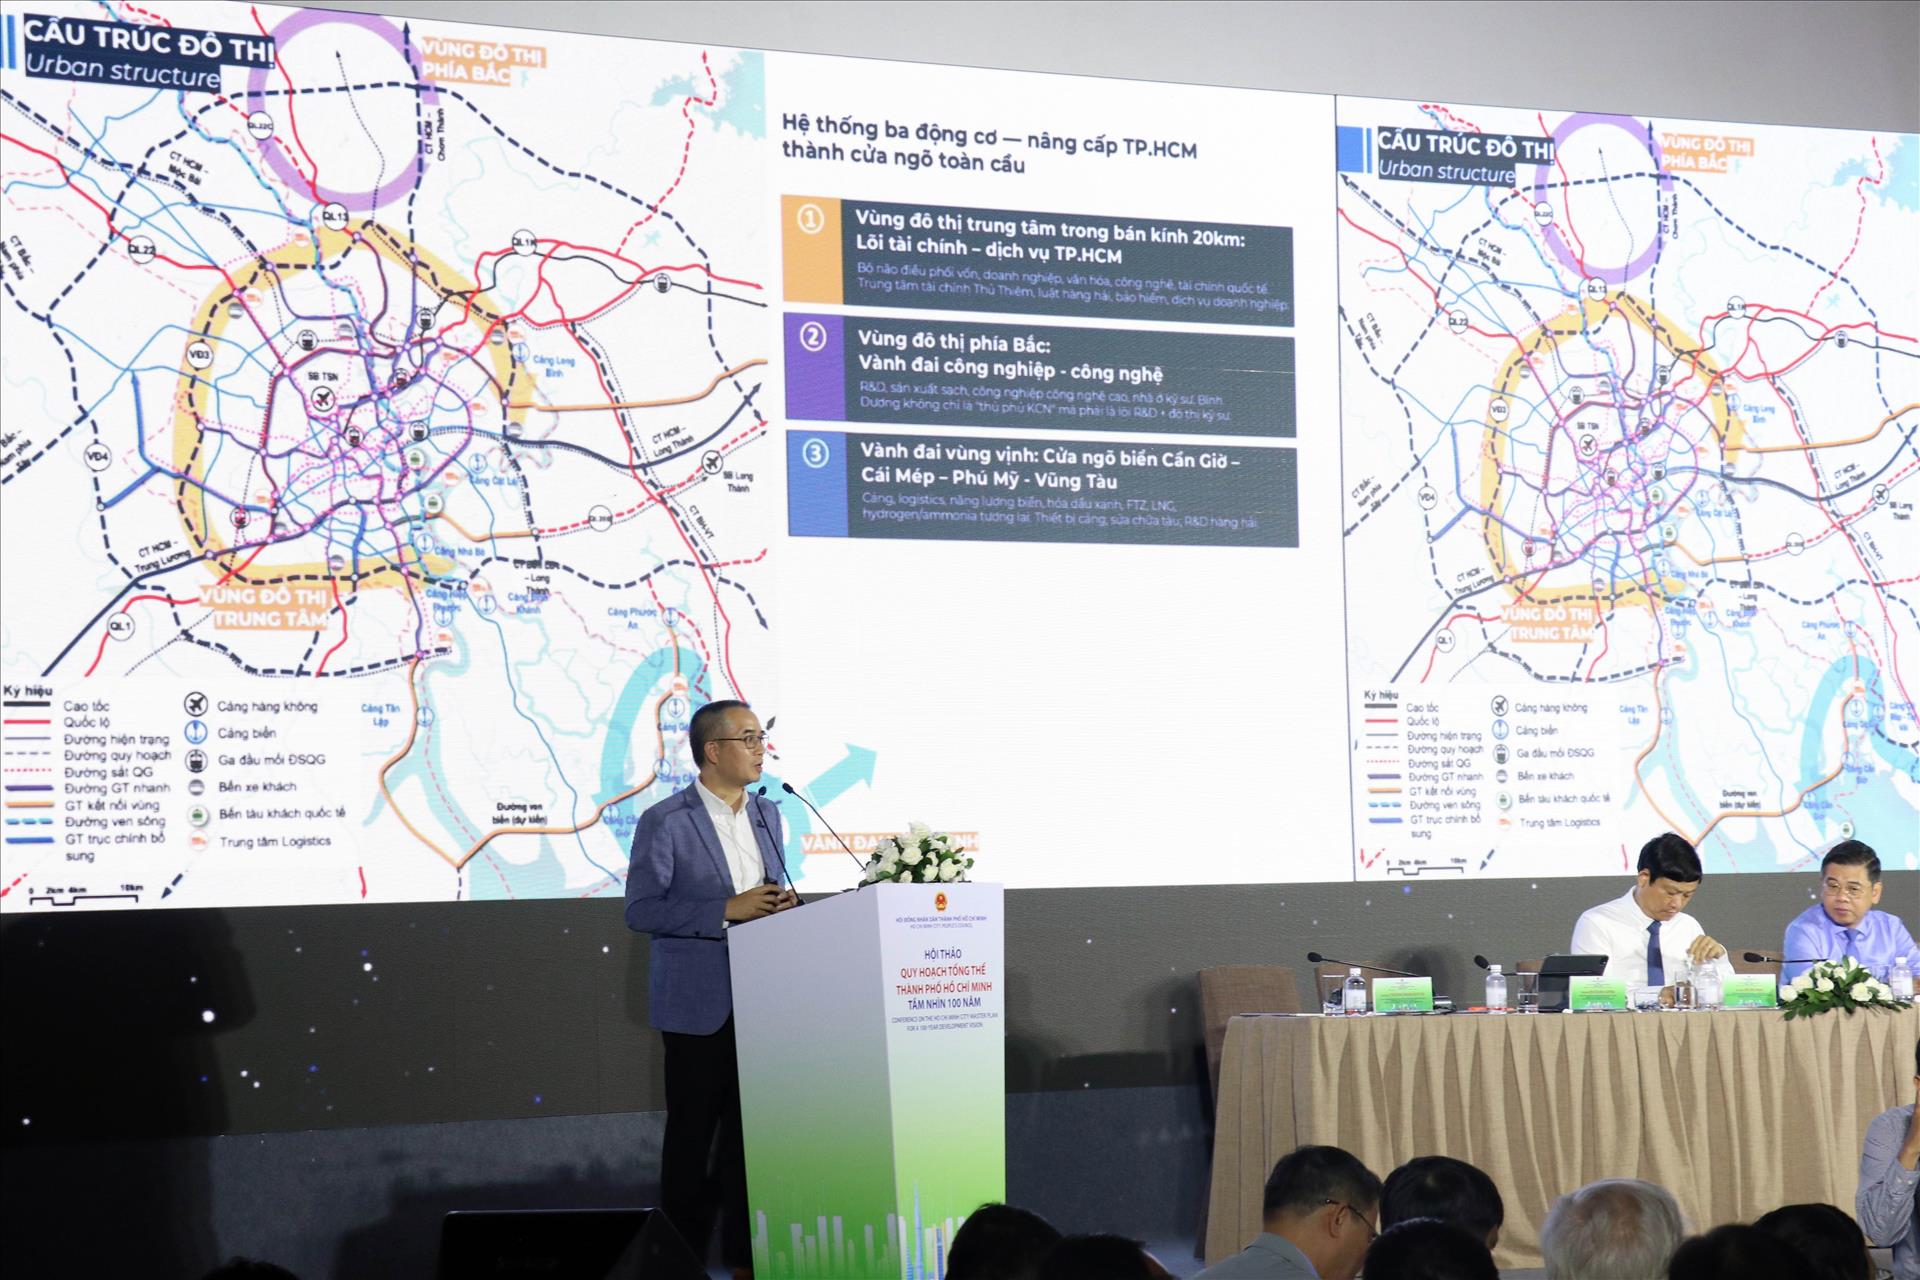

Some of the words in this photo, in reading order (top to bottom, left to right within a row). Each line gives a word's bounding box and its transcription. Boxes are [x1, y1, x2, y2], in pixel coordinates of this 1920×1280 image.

[94, 25, 172, 53] TRÚC
[178, 31, 222, 58] ĐÔ
[229, 38, 275, 69] THỊ
[26, 52, 104, 78] Urban
[110, 62, 221, 89] structure
[422, 61, 468, 80] PHÍA
[782, 113, 810, 135] Hệ
[816, 115, 878, 141] thống
[885, 120, 909, 139] ba
[916, 122, 967, 148] động
[974, 129, 998, 146] cơ
[1028, 132, 1077, 155] nâng
[1083, 134, 1118, 158] cấp
[1123, 138, 1197, 159] TP.HCM
[782, 140, 844, 161] thành
[851, 144, 888, 165] cửa
[894, 148, 933, 171] ngõ
[939, 150, 984, 172] toàn
[1426, 132, 1480, 155] TRÚC
[1486, 135, 1518, 158] ĐÔ
[1522, 141, 1555, 166] THỊ
[1379, 159, 1433, 178] Urban
[1437, 165, 1516, 184] structure
[855, 208, 905, 231] Vùng
[909, 211, 934, 230] đô
[937, 213, 963, 234] thị
[967, 216, 1016, 238] trung
[1021, 219, 1056, 237] tâm
[1061, 222, 1109, 243] trong
[1113, 223, 1146, 242] bán
[1150, 226, 1188, 245] kính
[1192, 229, 1246, 248] 20km:
[856, 233, 884, 251] Lõi
[889, 235, 912, 253] tài
[917, 236, 967, 256] chính
[985, 241, 1024, 262] dịch
[1028, 246, 1050, 264] vụ
[1054, 245, 1123, 264] TP.HCM
[858, 329, 908, 350] Vùng
[912, 331, 936, 349] đô
[939, 333, 965, 353] thị
[970, 334, 1008, 354] phía
[1013, 334, 1051, 354] Bắc:
[859, 354, 907, 373] Vành
[911, 356, 939, 373] đai
[943, 357, 989, 378] công
[993, 360, 1056, 381] nghiệp
[1070, 363, 1115, 384] công
[1119, 366, 1164, 386] nghệ
[861, 442, 908, 459] Vành
[913, 443, 941, 460] đai
[945, 445, 991, 465] vùng
[996, 446, 1039, 466] vịnh:
[1043, 447, 1078, 465] Cửa
[1082, 449, 1116, 468] ngõ
[1120, 449, 1158, 467] biển
[1199, 453, 1228, 469] Giờ
[861, 467, 890, 484] Cái
[896, 468, 935, 487] Mép
[952, 469, 988, 487] Phú
[994, 470, 1019, 490] Mỹ
[1035, 472, 1082, 492] Vũng
[1086, 473, 1118, 491] Tàu
[863, 507, 978, 522] hydrogen/ammonia
[215, 610, 281, 627] TRUNG
[63, 700, 89, 712] Cao
[64, 733, 107, 748] Đường
[64, 750, 107, 763] Đường
[111, 751, 132, 762] quy
[218, 754, 236, 766] Ga
[288, 753, 326, 766] ĐSQG
[64, 766, 108, 780] Đường
[132, 766, 154, 778] QG
[64, 782, 108, 796] Đường
[111, 782, 130, 794] GT
[133, 782, 171, 793] nhanh
[245, 784, 259, 792] xe
[262, 782, 297, 792] khách
[65, 800, 83, 811] GT
[267, 808, 301, 819] khách
[65, 816, 109, 830] Đường
[112, 818, 134, 827] ven
[137, 816, 166, 829] sông
[65, 833, 84, 845] GT
[220, 836, 254, 850] Trung
[282, 836, 332, 849] Logistics
[66, 851, 95, 863] sung
[924, 948, 940, 962] HỘI
[900, 967, 918, 979] QUY
[919, 967, 947, 980] HOẠCH
[956, 981, 970, 993] CHÍ
[971, 981, 993, 992] MINH
[948, 998, 962, 1009] 100
